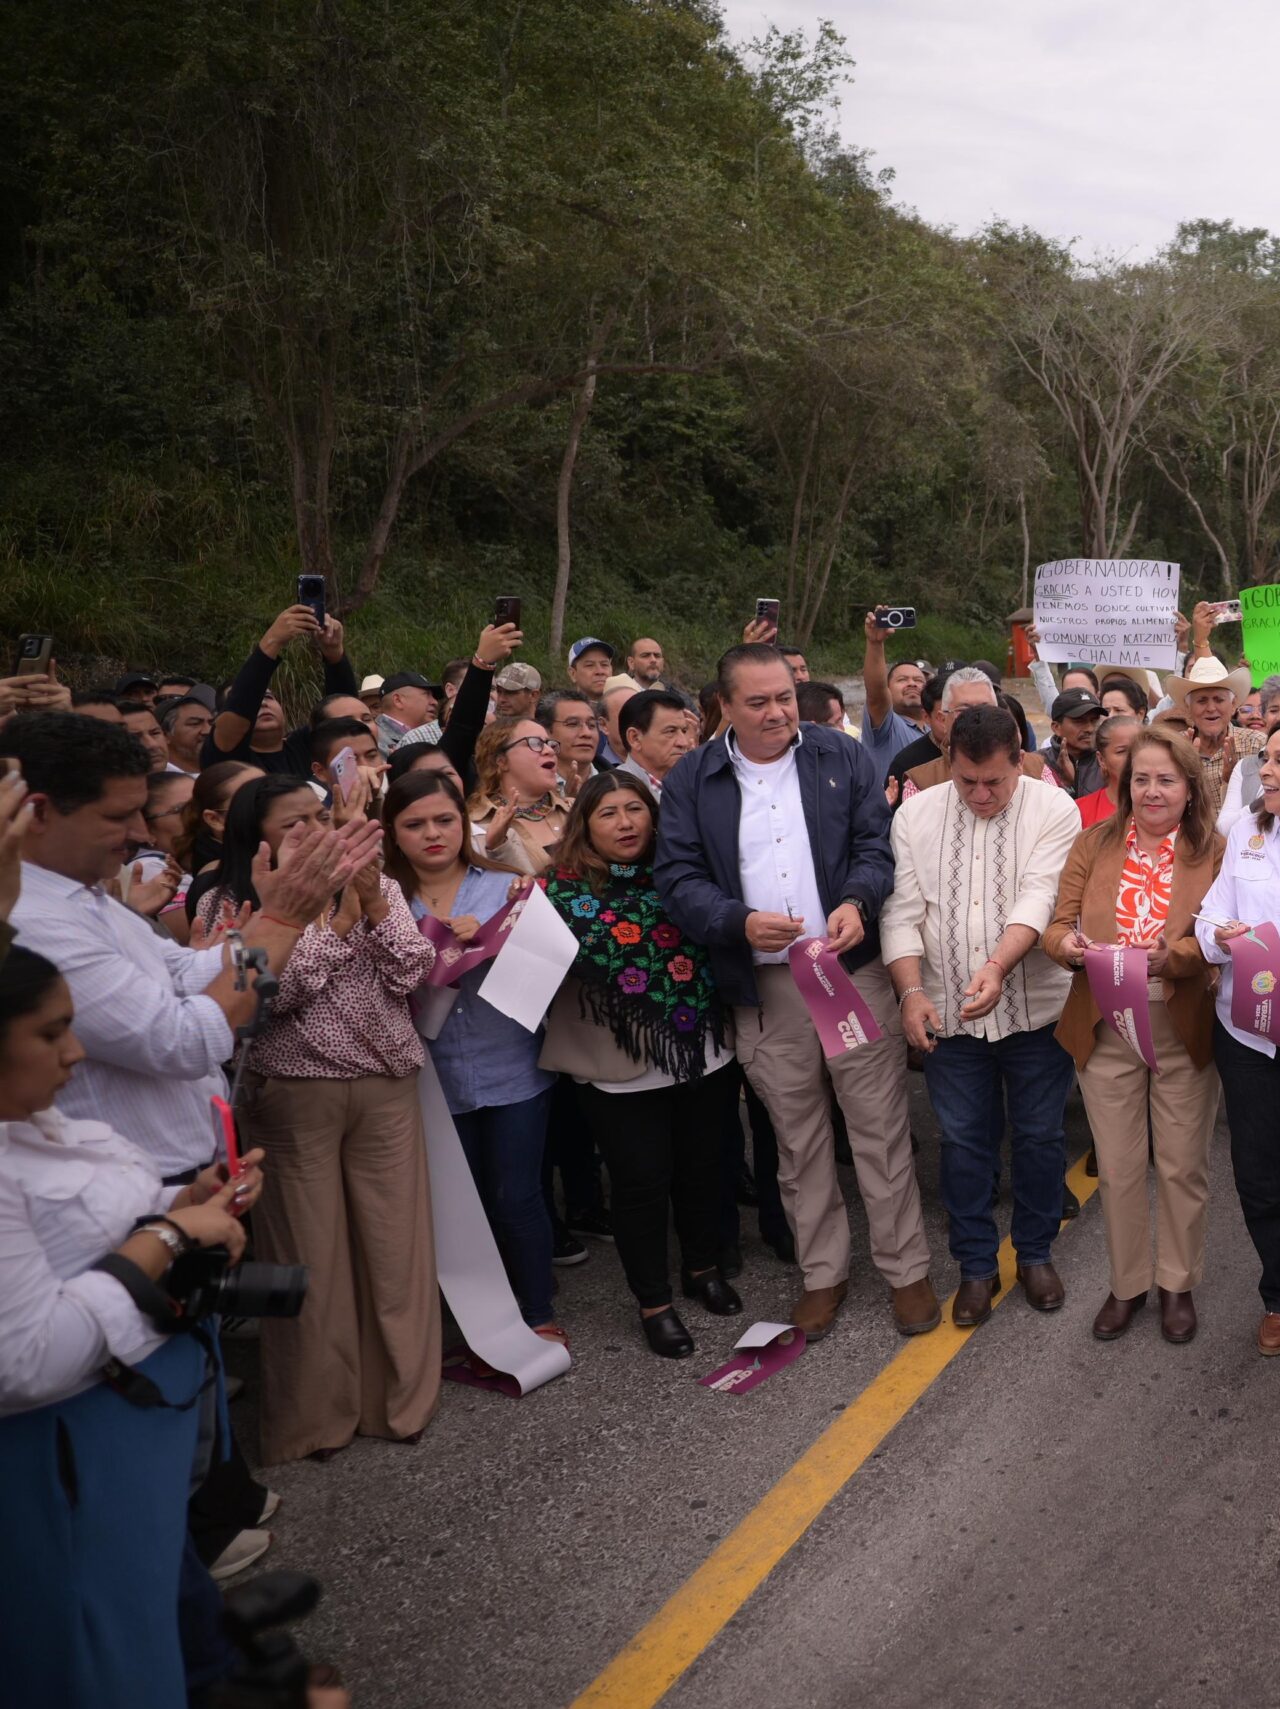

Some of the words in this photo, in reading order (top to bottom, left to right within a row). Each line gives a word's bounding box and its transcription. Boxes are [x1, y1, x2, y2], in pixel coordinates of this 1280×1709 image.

[1034, 583, 1079, 597] GRACIAS
[1085, 585, 1092, 597] A
[1100, 585, 1144, 598] USTED
[1035, 601, 1089, 612] TENEMOS
[1095, 604, 1131, 613] DONDE
[1135, 605, 1176, 613] CULTIVAR
[1039, 616, 1089, 626] NUESTROS
[1095, 618, 1128, 626] PROPIOS
[1044, 632, 1117, 645] COMUNEROS
